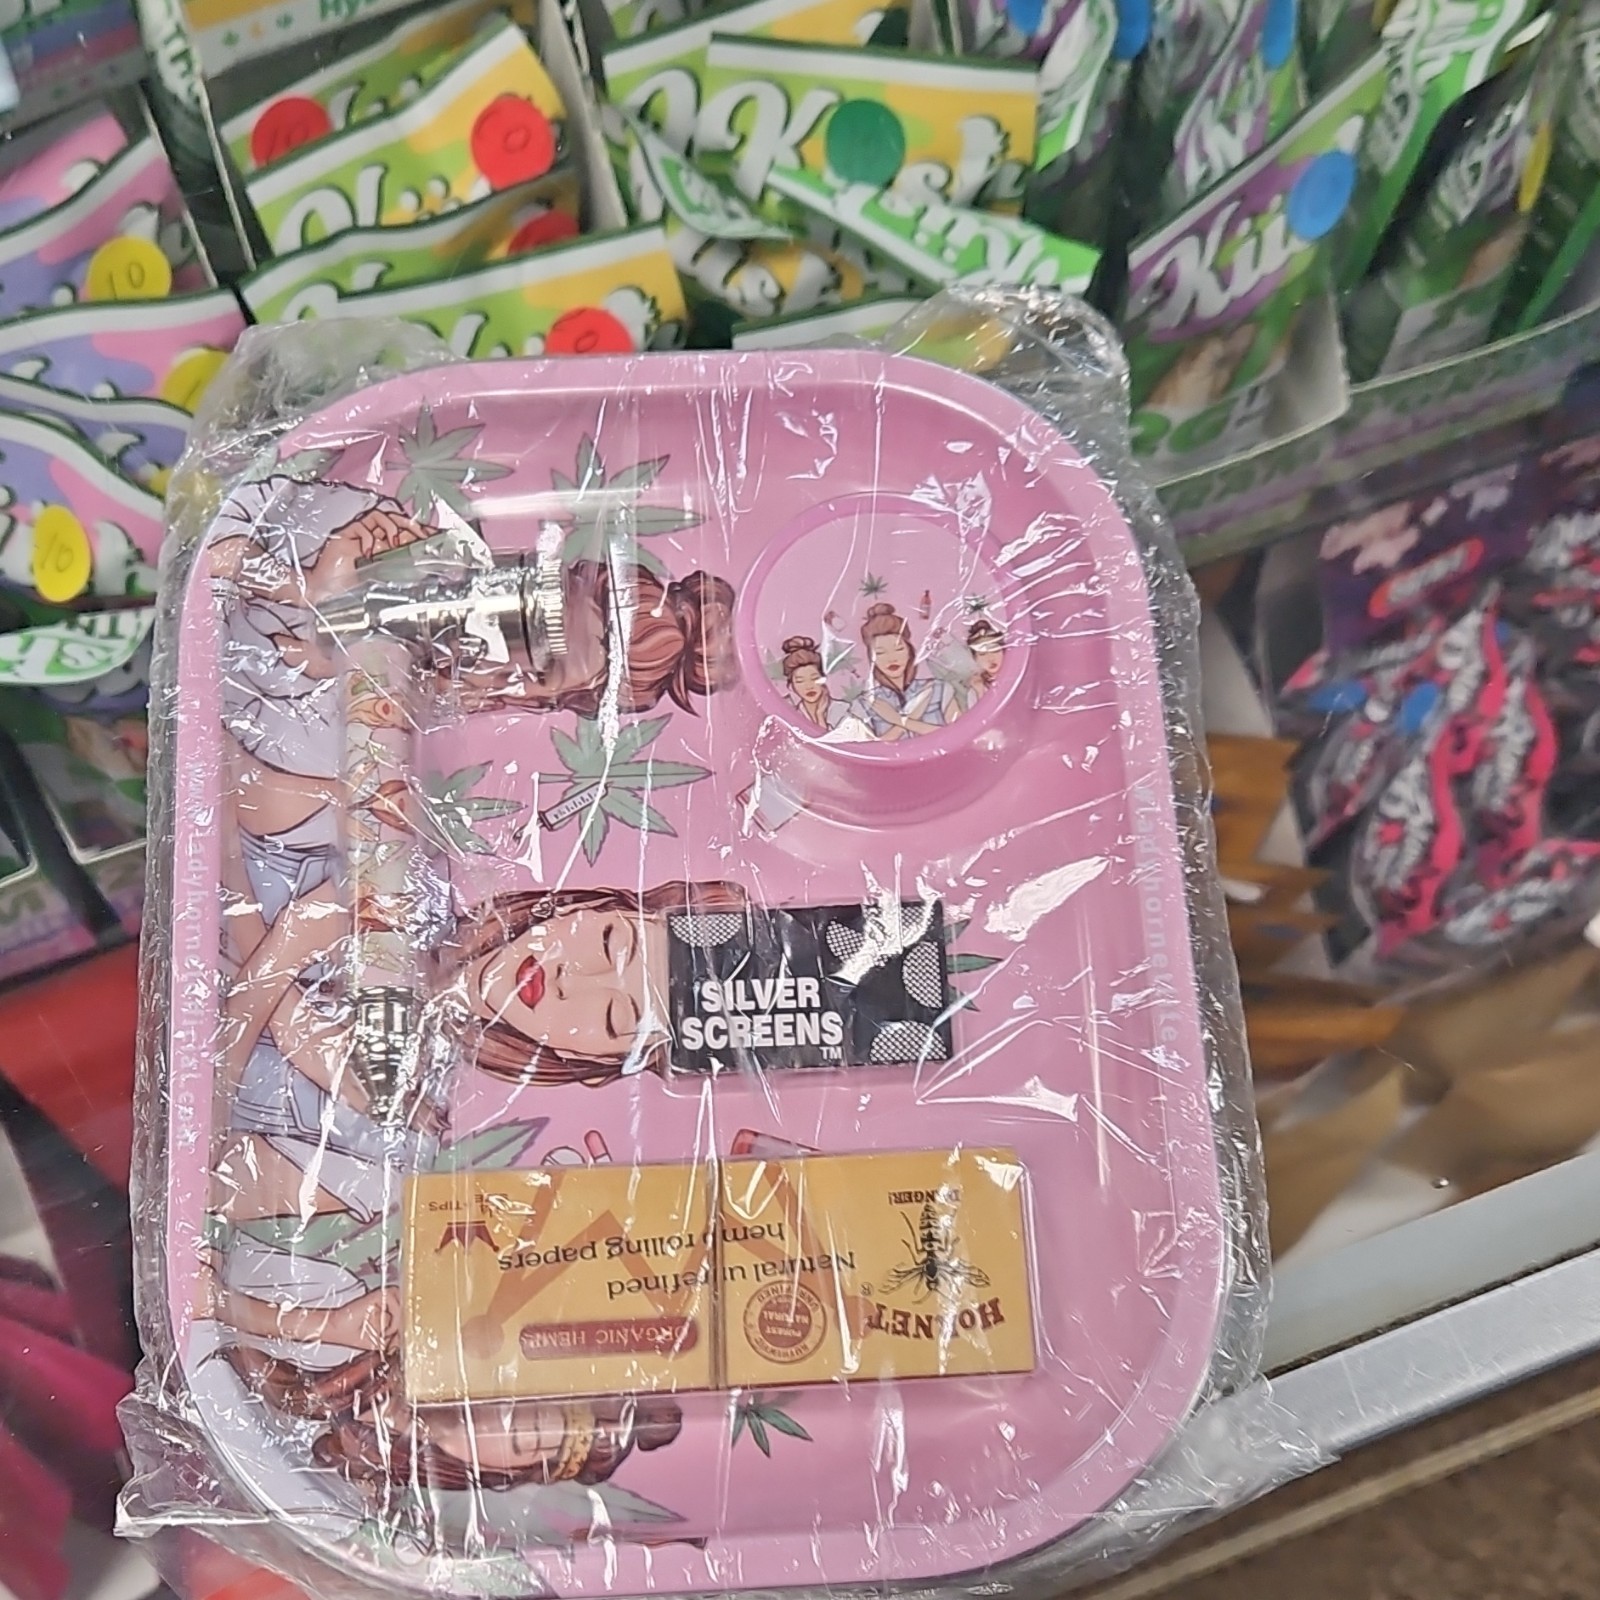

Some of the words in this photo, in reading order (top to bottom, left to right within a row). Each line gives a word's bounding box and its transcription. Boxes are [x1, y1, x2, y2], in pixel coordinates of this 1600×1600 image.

[700, 976, 822, 1013] SILVER
[681, 1010, 845, 1051] SCREENS
[886, 1188, 962, 1206] DNGER!
[497, 1241, 599, 1273] papers
[604, 1233, 696, 1260] rolling
[752, 1250, 857, 1283] Natural
[756, 1284, 820, 1313] UNRFINED
[595, 1324, 688, 1347] ORGANIC
